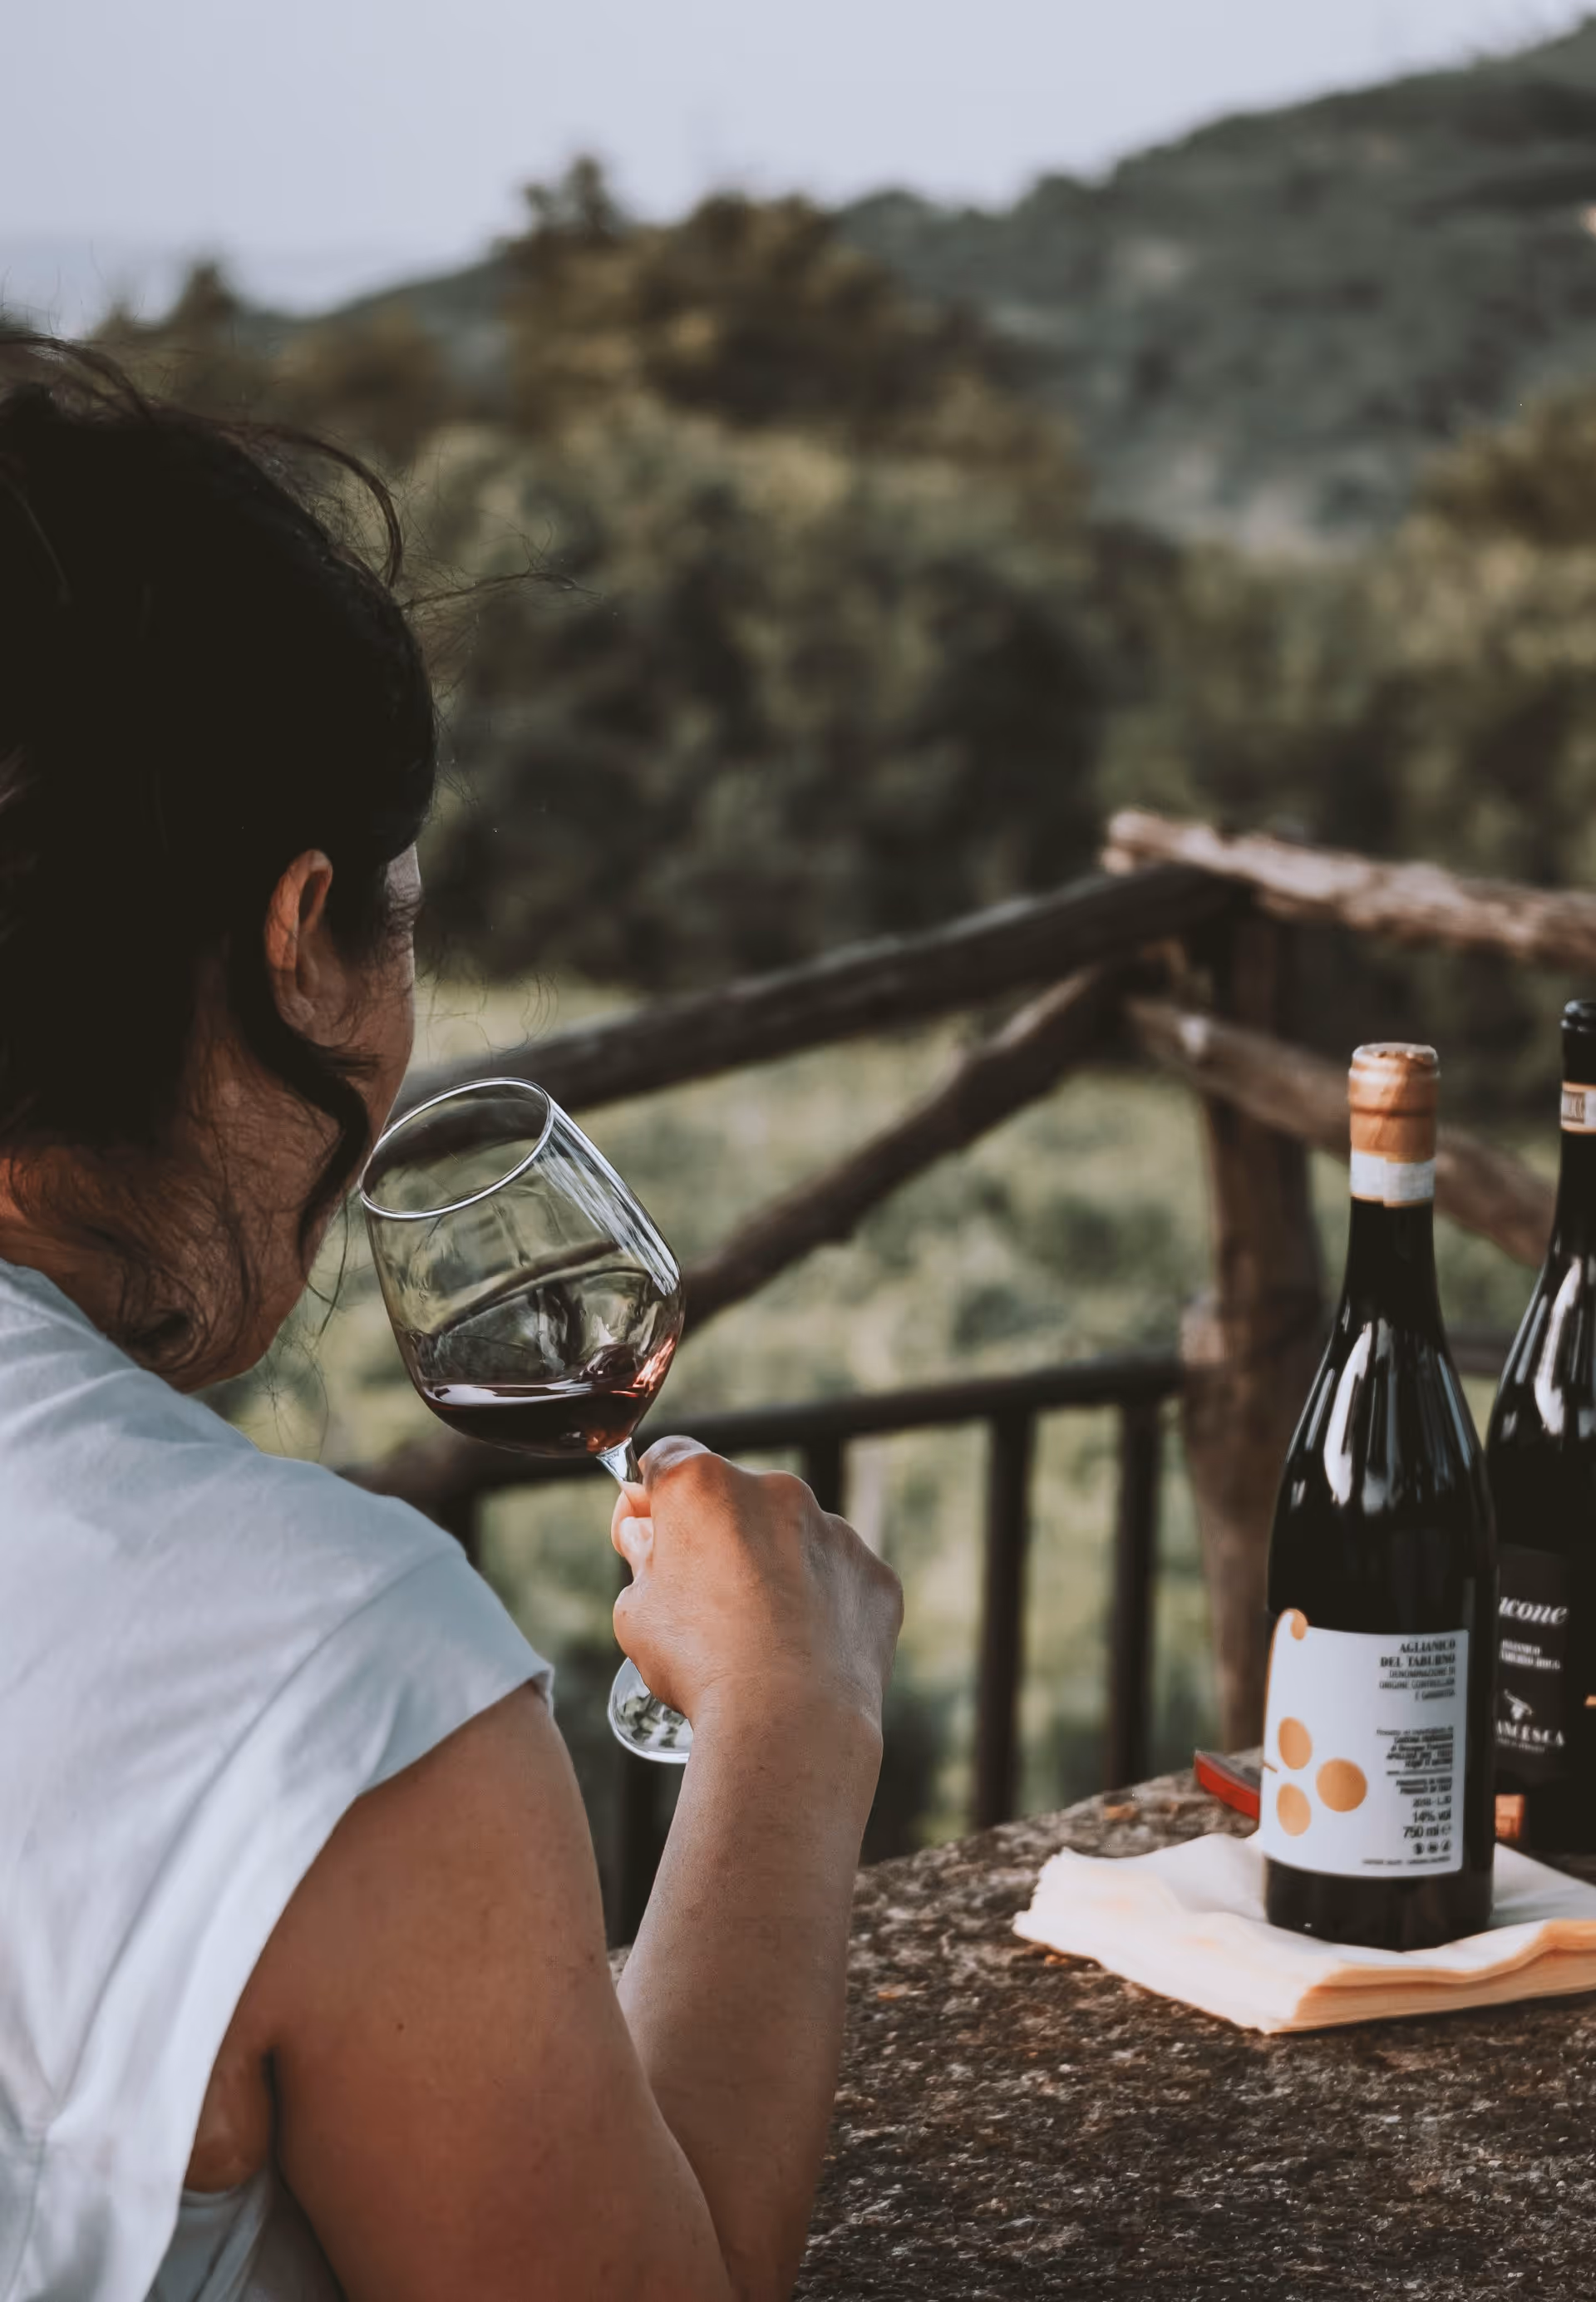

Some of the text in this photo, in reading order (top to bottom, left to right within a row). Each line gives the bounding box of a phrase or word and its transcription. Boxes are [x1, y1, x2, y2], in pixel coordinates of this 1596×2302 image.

[1399, 1639, 1456, 1654] AGLIANICO
[1380, 1653, 1456, 1668] DEL TABURNO
[1413, 1807, 1451, 1823] 14% vol
[1402, 1826, 1424, 1838] 750
[1426, 1824, 1439, 1836] ml
